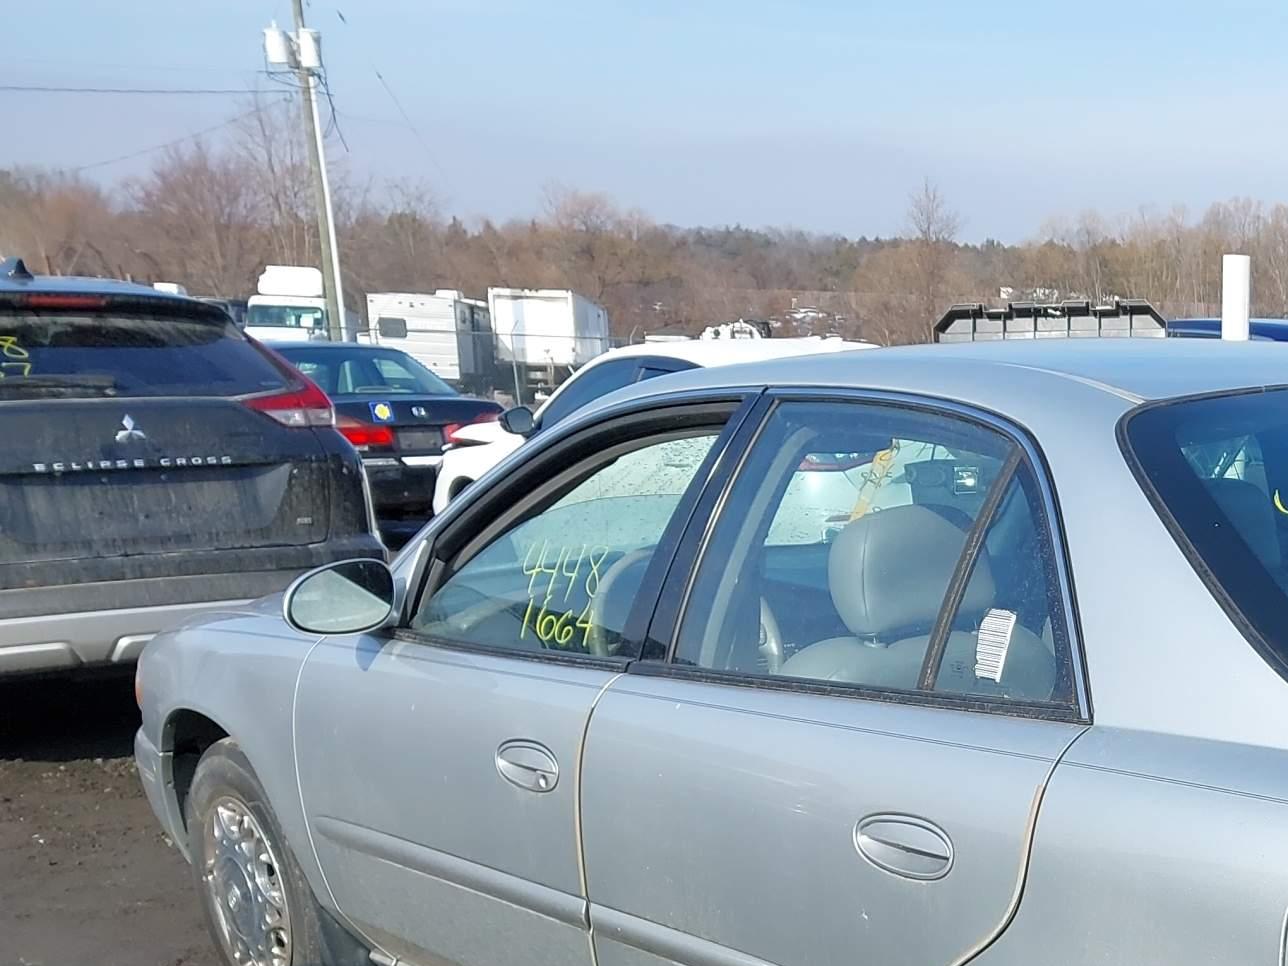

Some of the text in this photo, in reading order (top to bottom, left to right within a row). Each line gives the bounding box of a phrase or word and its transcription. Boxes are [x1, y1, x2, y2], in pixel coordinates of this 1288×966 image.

[32, 455, 232, 473] ECLIPSE CROSS
[522, 539, 609, 604] 4448
[520, 595, 595, 647] 1664
